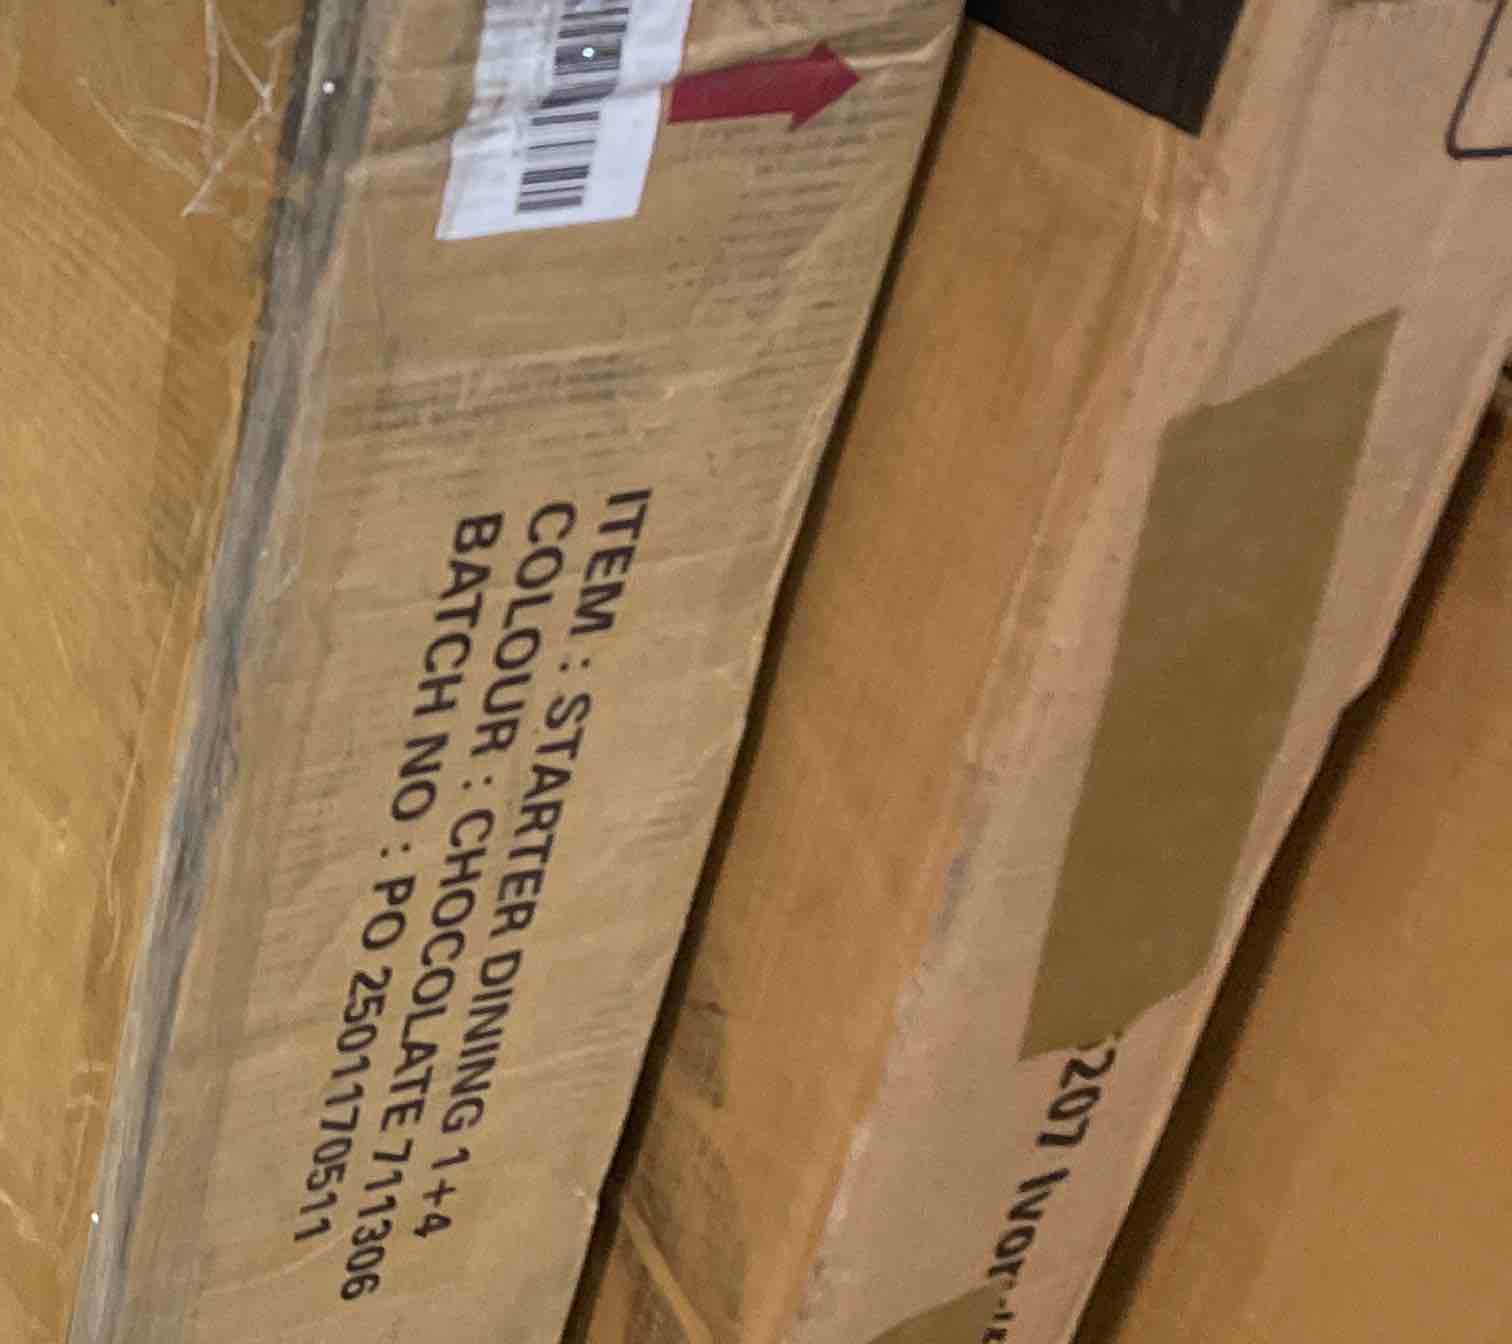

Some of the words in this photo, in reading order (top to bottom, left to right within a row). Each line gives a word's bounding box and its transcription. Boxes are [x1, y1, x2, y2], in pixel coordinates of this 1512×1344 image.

[413, 511, 504, 716] BATCH
[476, 502, 577, 754] COLOUR
[570, 488, 652, 638] ITEM
[391, 732, 447, 822] NO
[489, 692, 591, 933] STARTER
[360, 874, 416, 952] PO
[381, 810, 495, 1134] CHOCOLATE
[295, 968, 393, 1242] 2501170511
[442, 947, 525, 1134] DINING
[340, 1137, 413, 1304] 711306
[413, 1145, 472, 1238] 1+4
